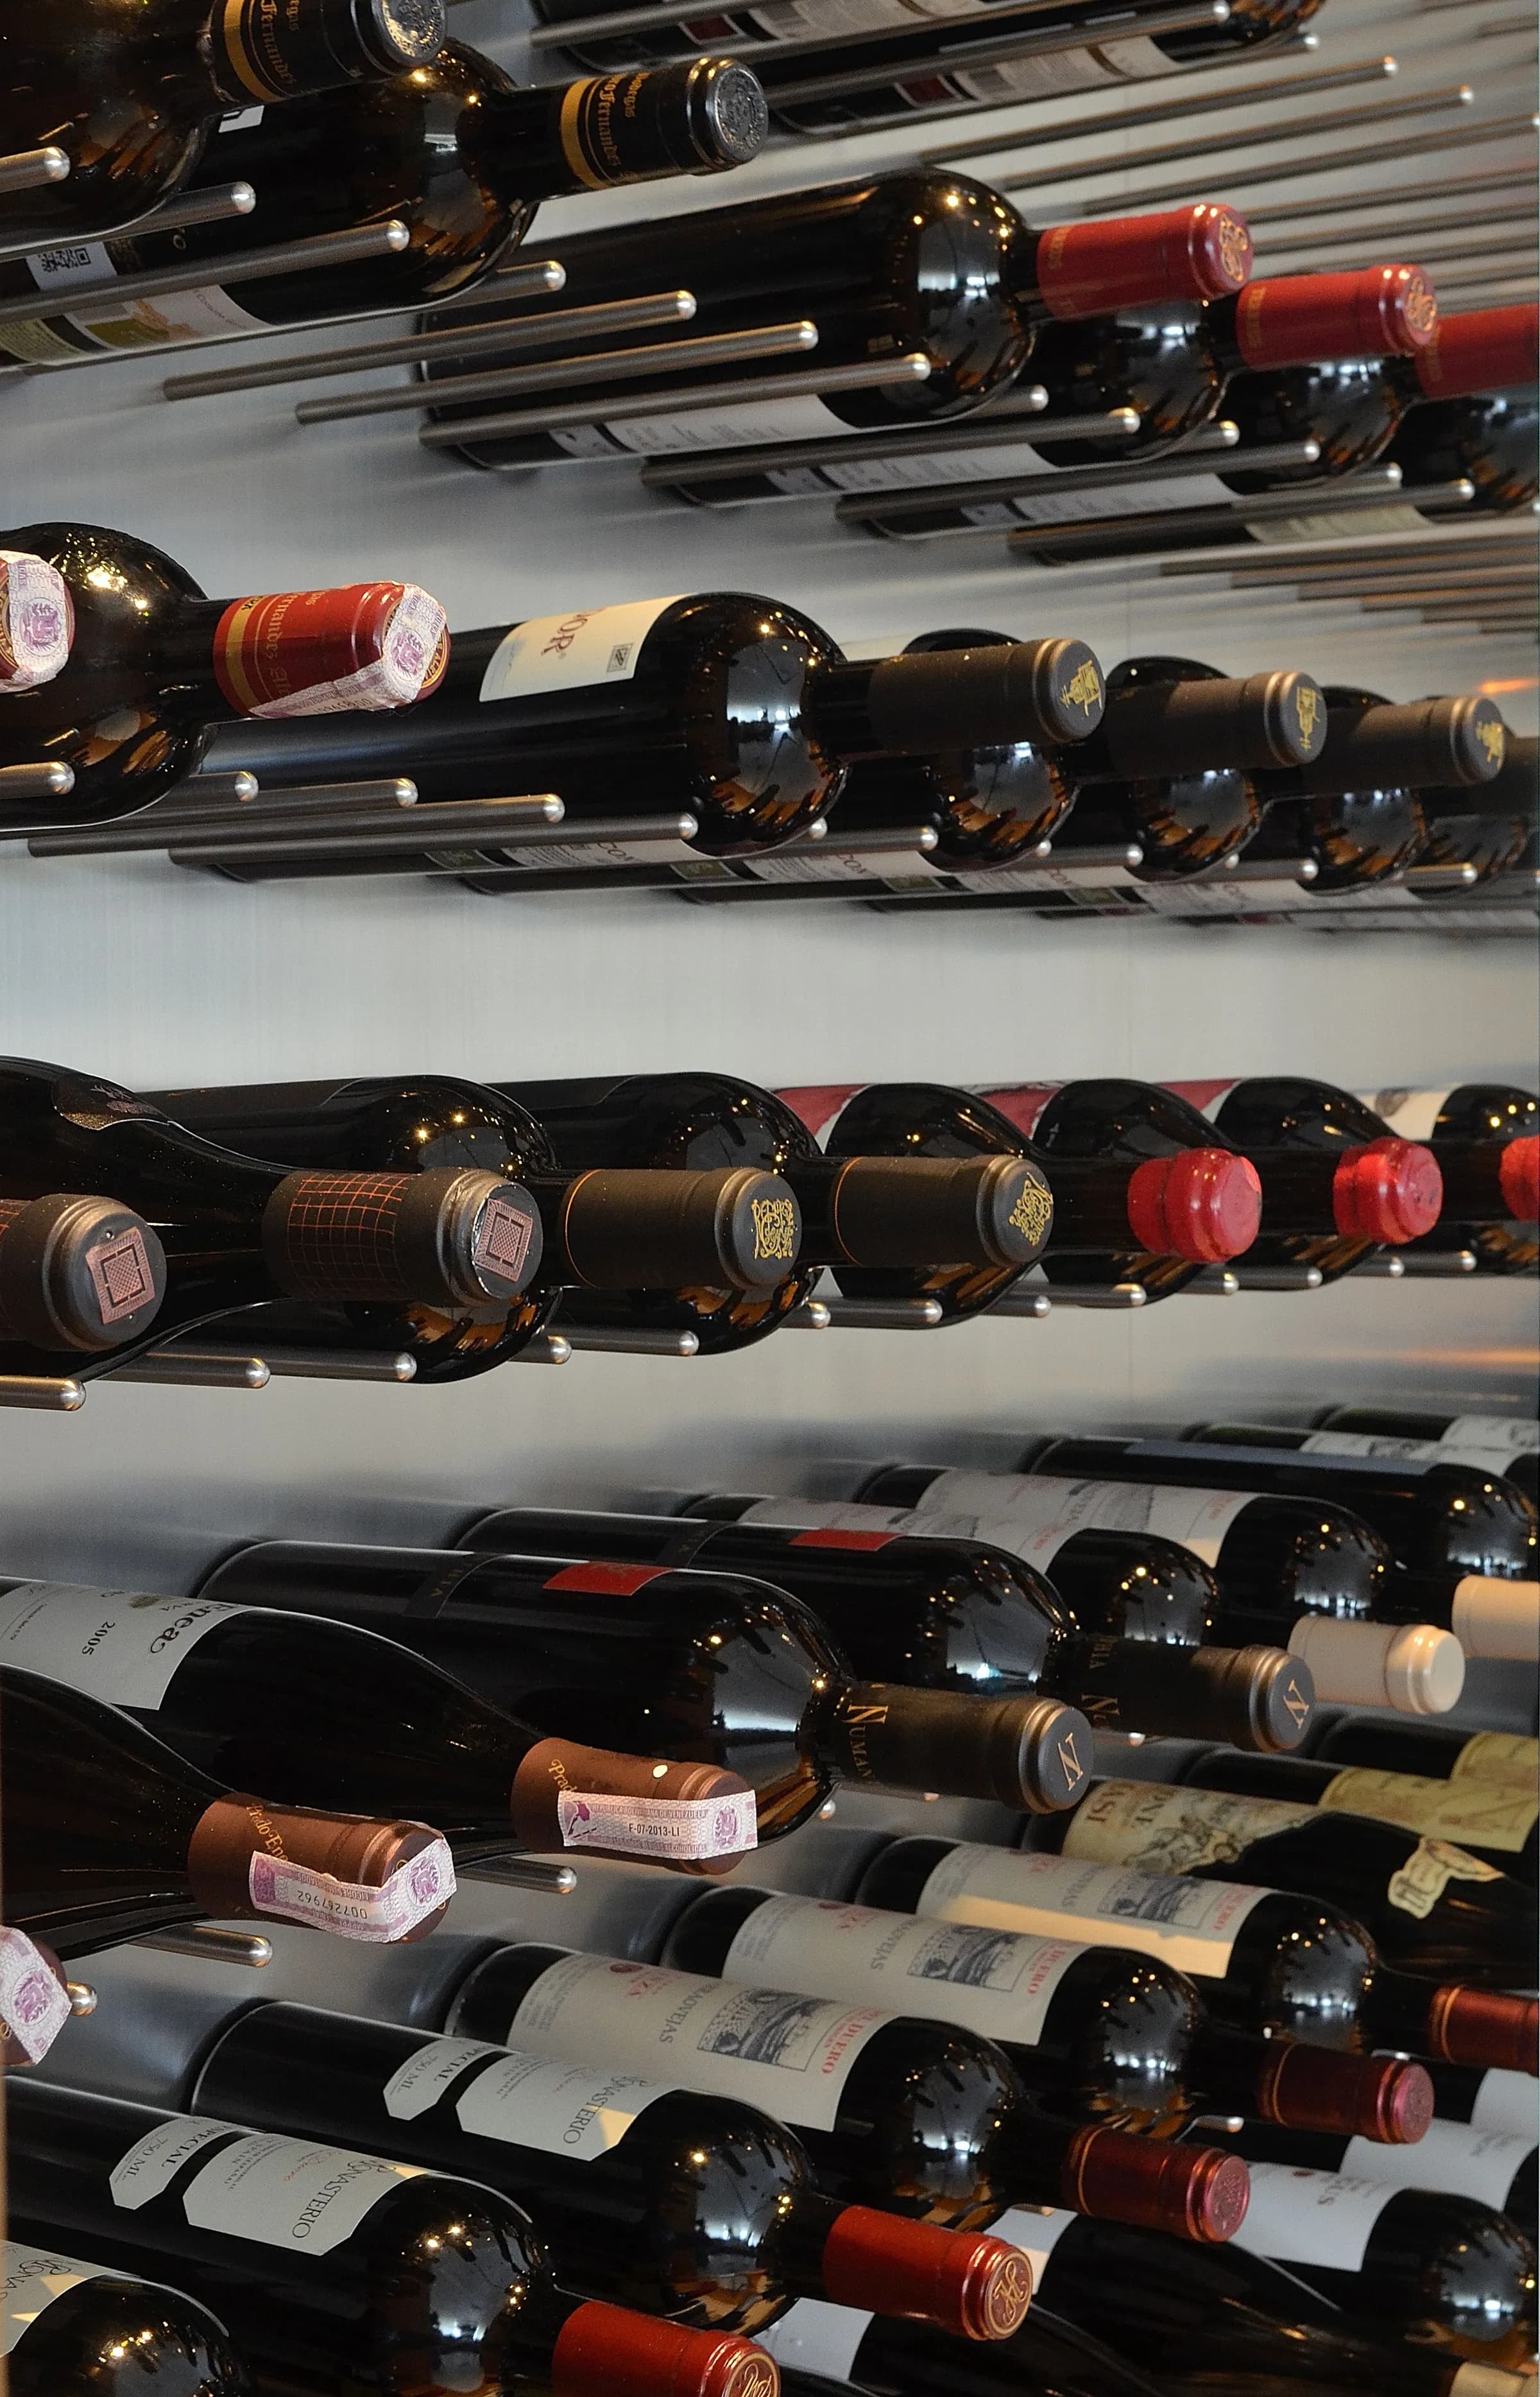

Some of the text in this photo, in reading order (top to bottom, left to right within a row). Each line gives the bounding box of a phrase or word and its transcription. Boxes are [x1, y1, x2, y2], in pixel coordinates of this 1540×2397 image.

[82, 1621, 116, 1656] 2005
[548, 1758, 577, 1792] Prad
[629, 1823, 680, 1837] F-07-2013-LI
[142, 2135, 169, 2157] 750
